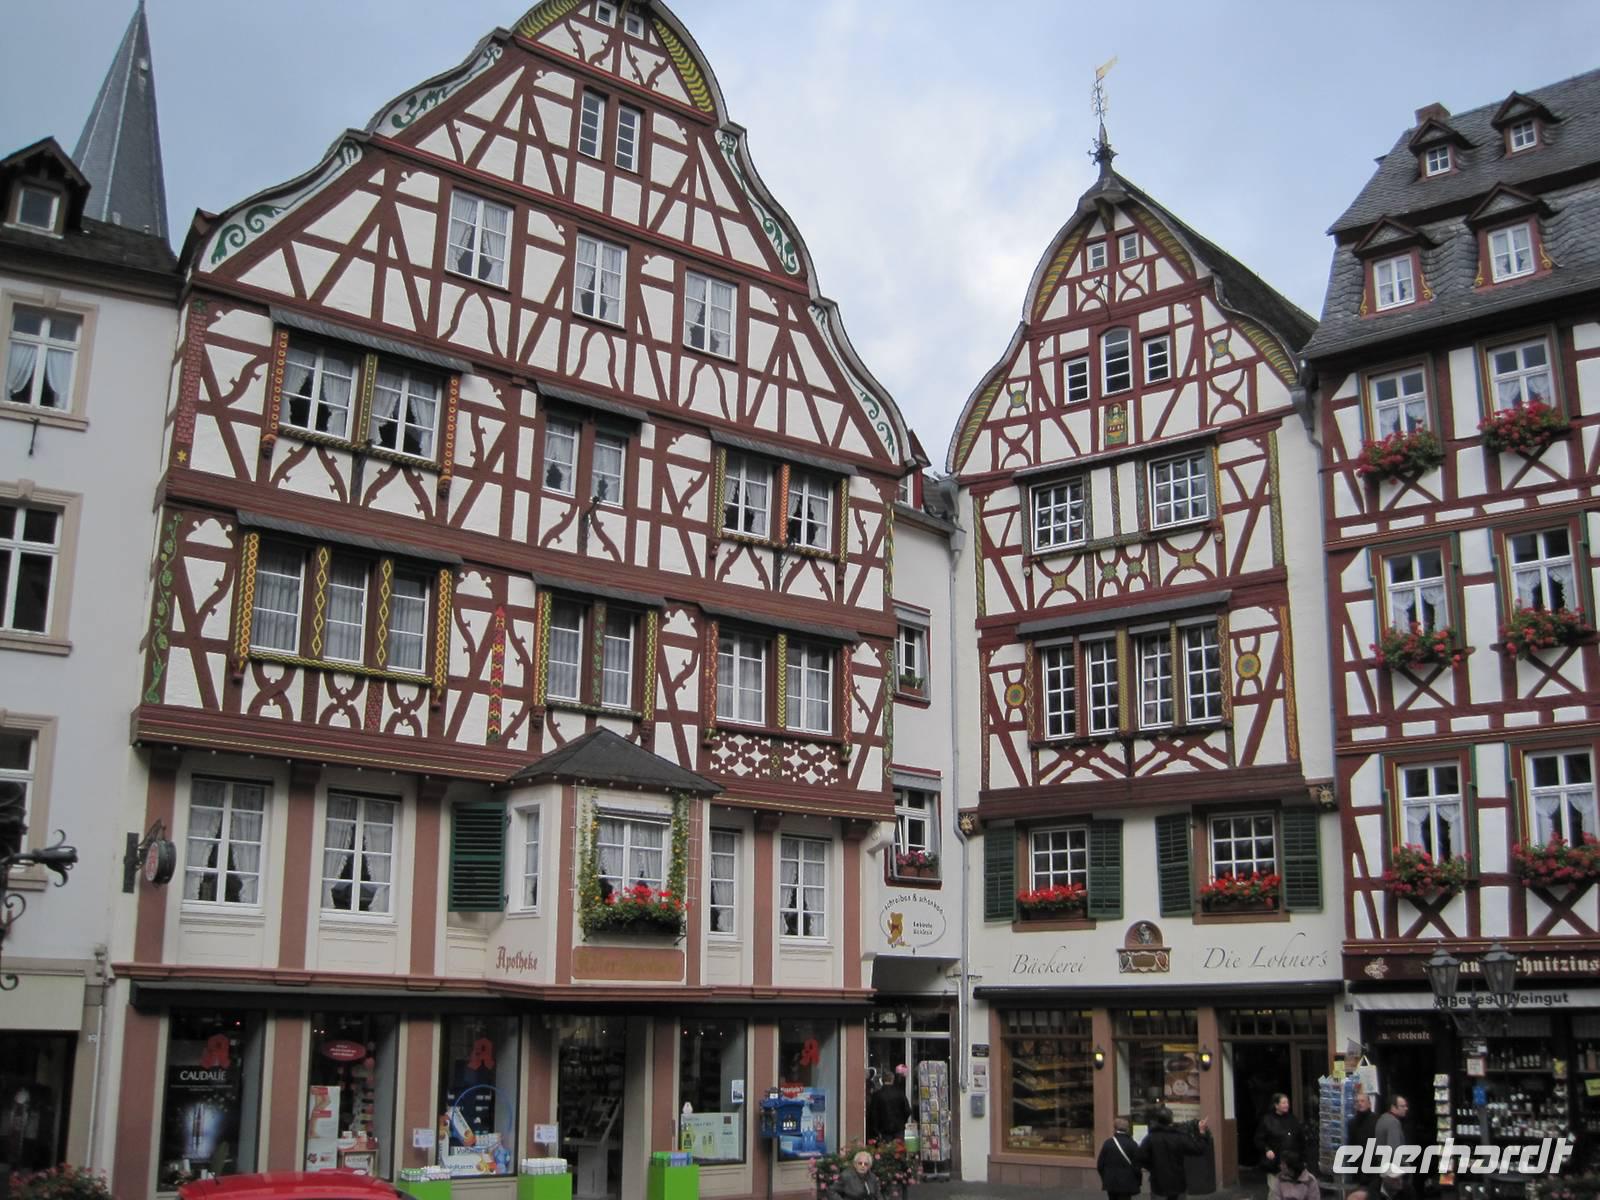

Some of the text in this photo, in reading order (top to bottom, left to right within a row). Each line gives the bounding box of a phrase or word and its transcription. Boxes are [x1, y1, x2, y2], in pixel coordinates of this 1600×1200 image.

[496, 945, 538, 974] Apotheke
[1012, 945, 1085, 974] Bäckerei
[1203, 946, 1241, 969] Die
